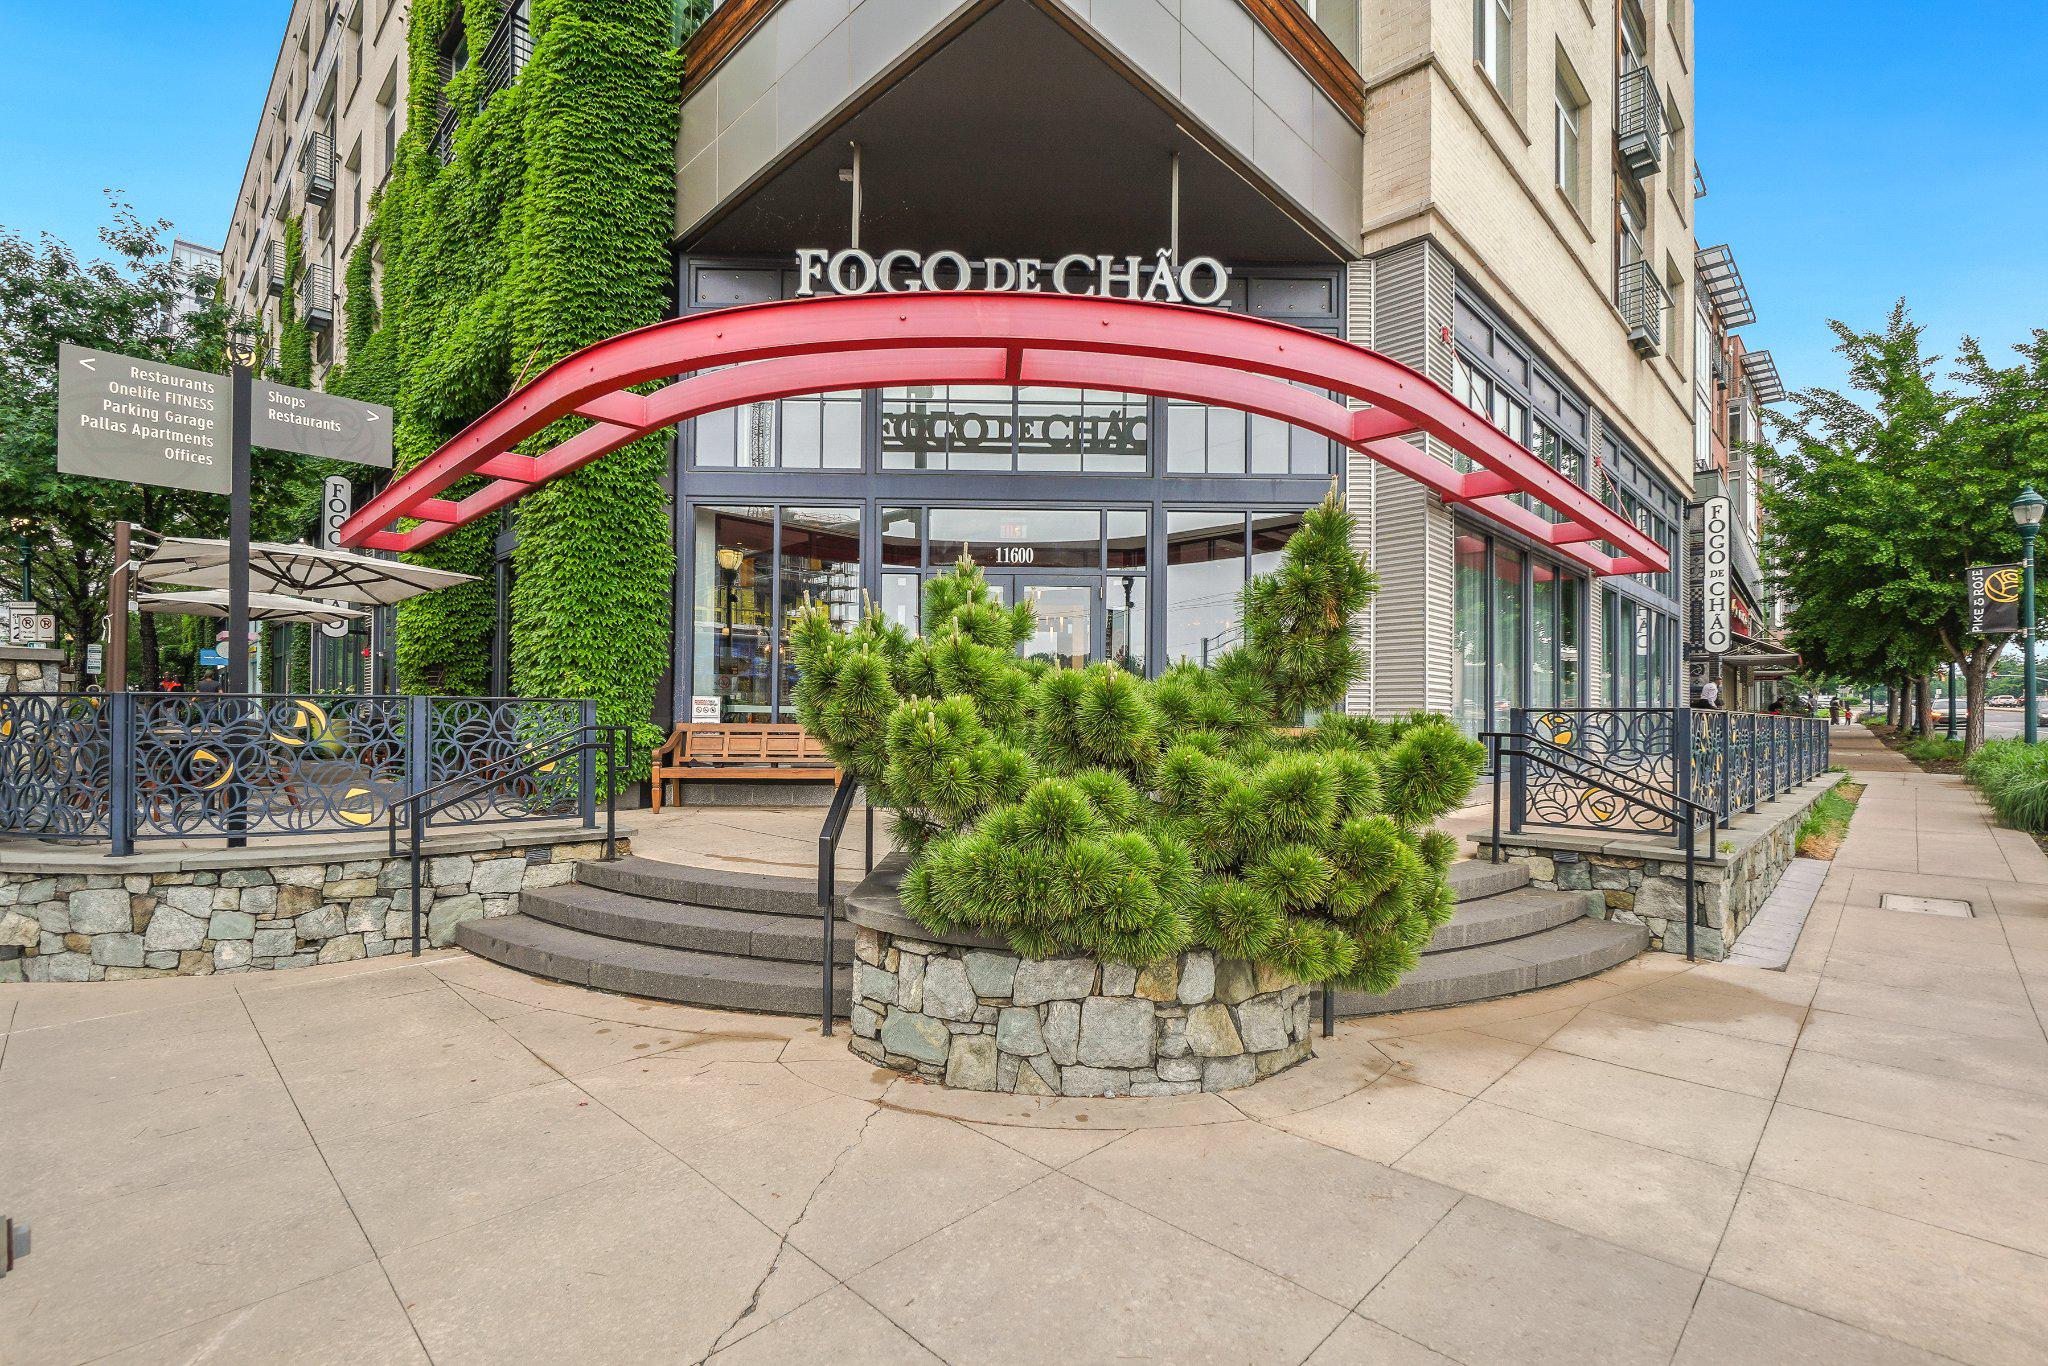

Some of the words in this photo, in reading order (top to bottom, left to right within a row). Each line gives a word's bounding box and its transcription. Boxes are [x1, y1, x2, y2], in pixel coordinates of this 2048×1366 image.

[796, 248, 971, 297] FOGO
[984, 258, 1042, 293] DE
[1052, 247, 1228, 305] CHÃO
[130, 366, 215, 394] Restaurants
[109, 381, 160, 402] Onelife
[165, 391, 214, 412] FITNESS
[268, 391, 306, 409] Shops
[103, 399, 159, 424] Parking
[165, 410, 214, 431] Garage
[268, 408, 342, 432] Restaurants
[81, 414, 127, 433] Pallas
[132, 423, 214, 448] Apartments
[164, 447, 213, 465] Offices
[1708, 505, 1726, 564] FOGO
[995, 547, 1034, 563] 11600
[1709, 569, 1725, 578] DE
[1972, 569, 1984, 596] ROSE
[1708, 582, 1726, 645] CHÃO
[1973, 598, 1984, 606] &
[1972, 608, 1984, 632] PIKE
